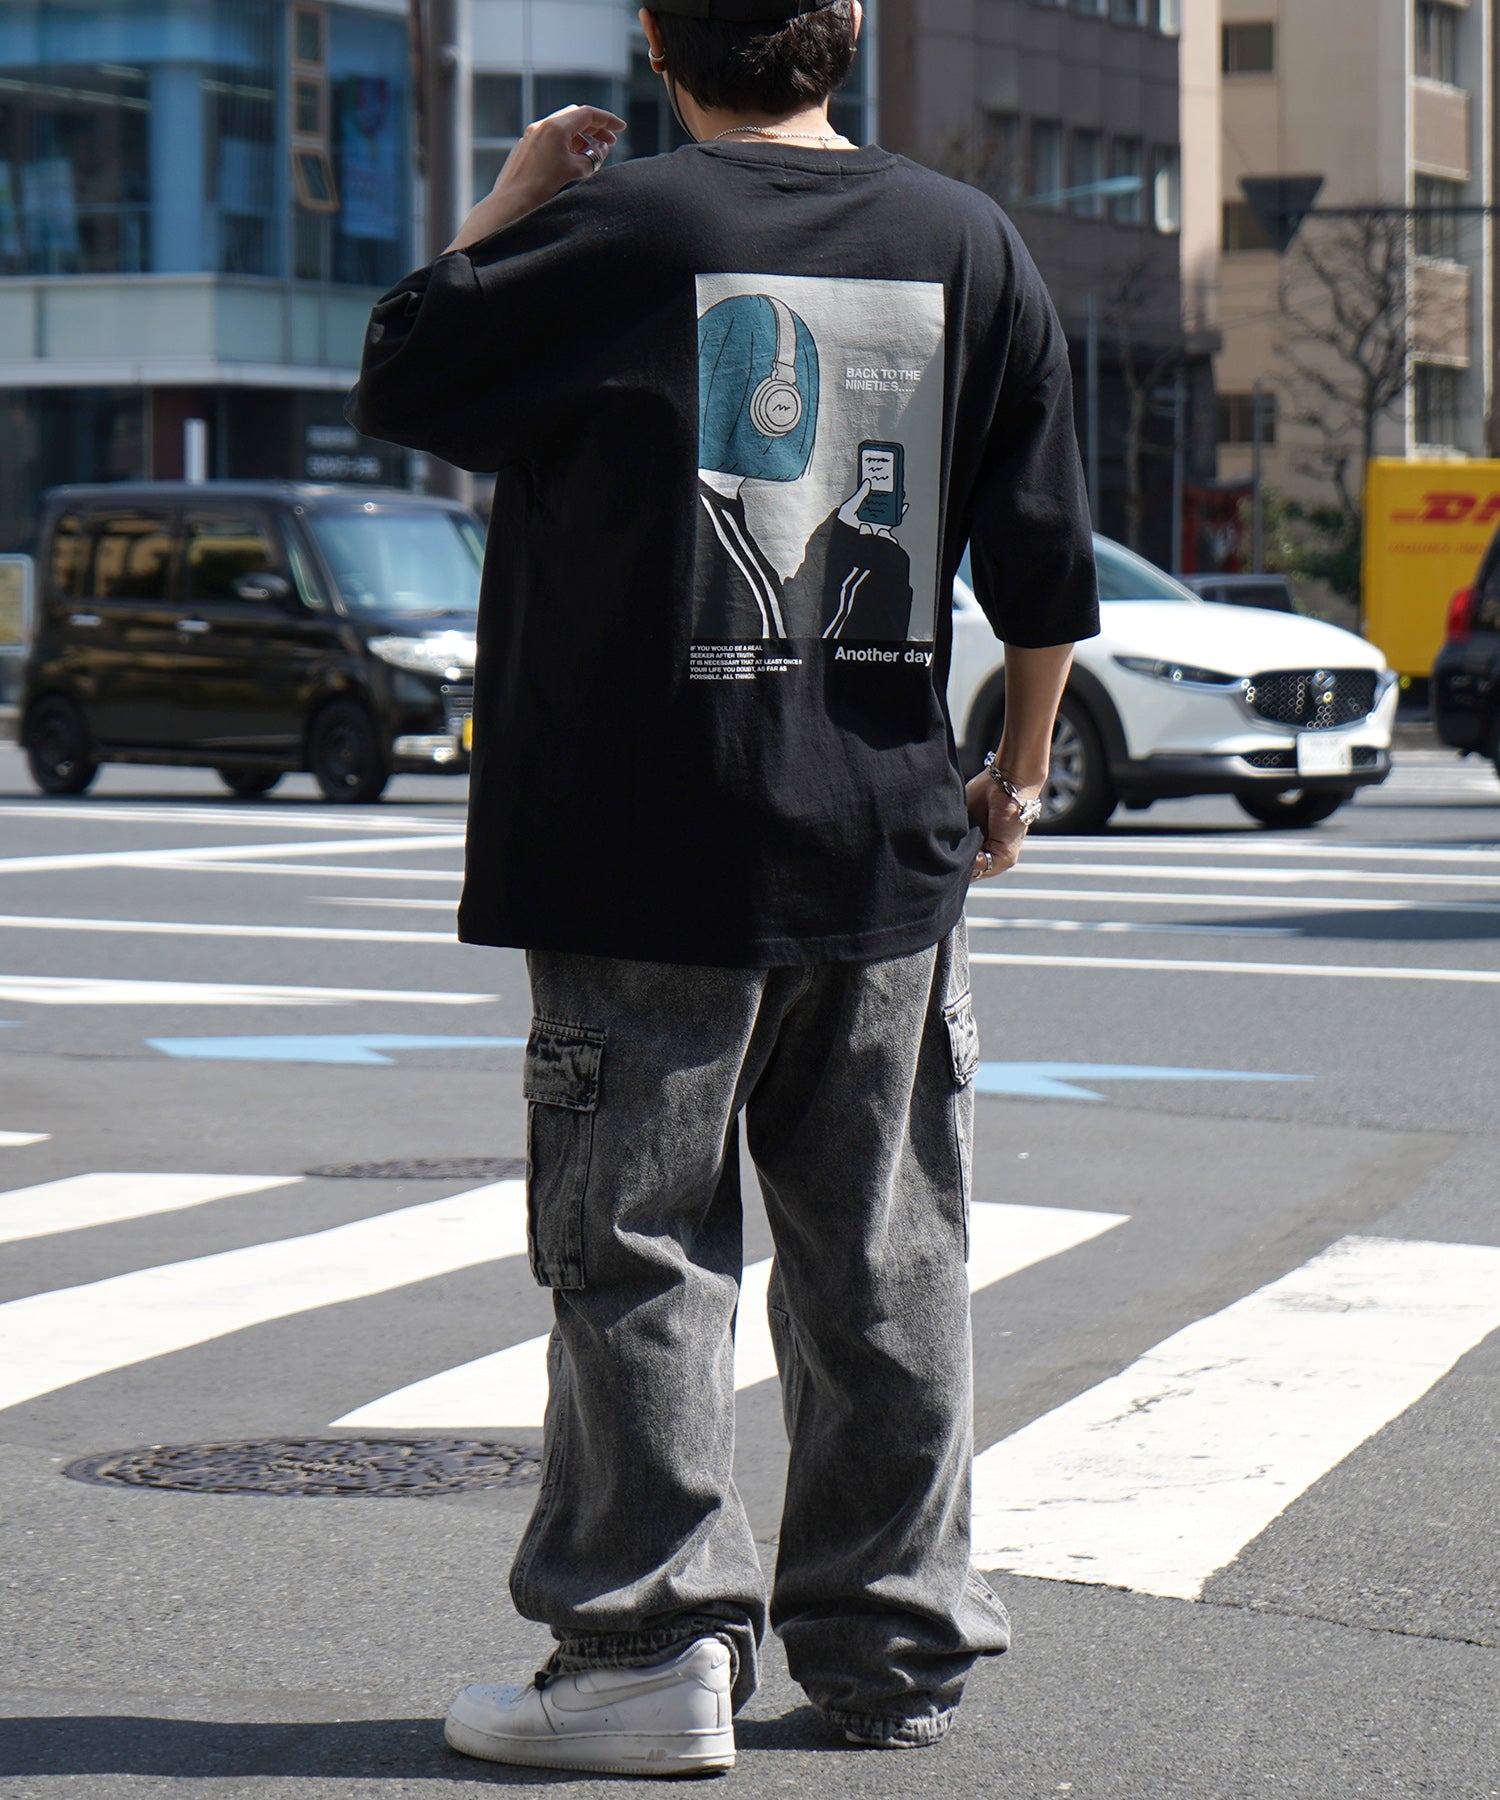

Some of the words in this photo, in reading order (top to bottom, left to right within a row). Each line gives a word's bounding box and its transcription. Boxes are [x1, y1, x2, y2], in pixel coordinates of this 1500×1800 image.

[846, 367, 879, 379] BACK
[880, 369, 898, 380] TO
[898, 370, 921, 381] THE
[834, 645, 900, 663] Another
[903, 648, 933, 667] day
